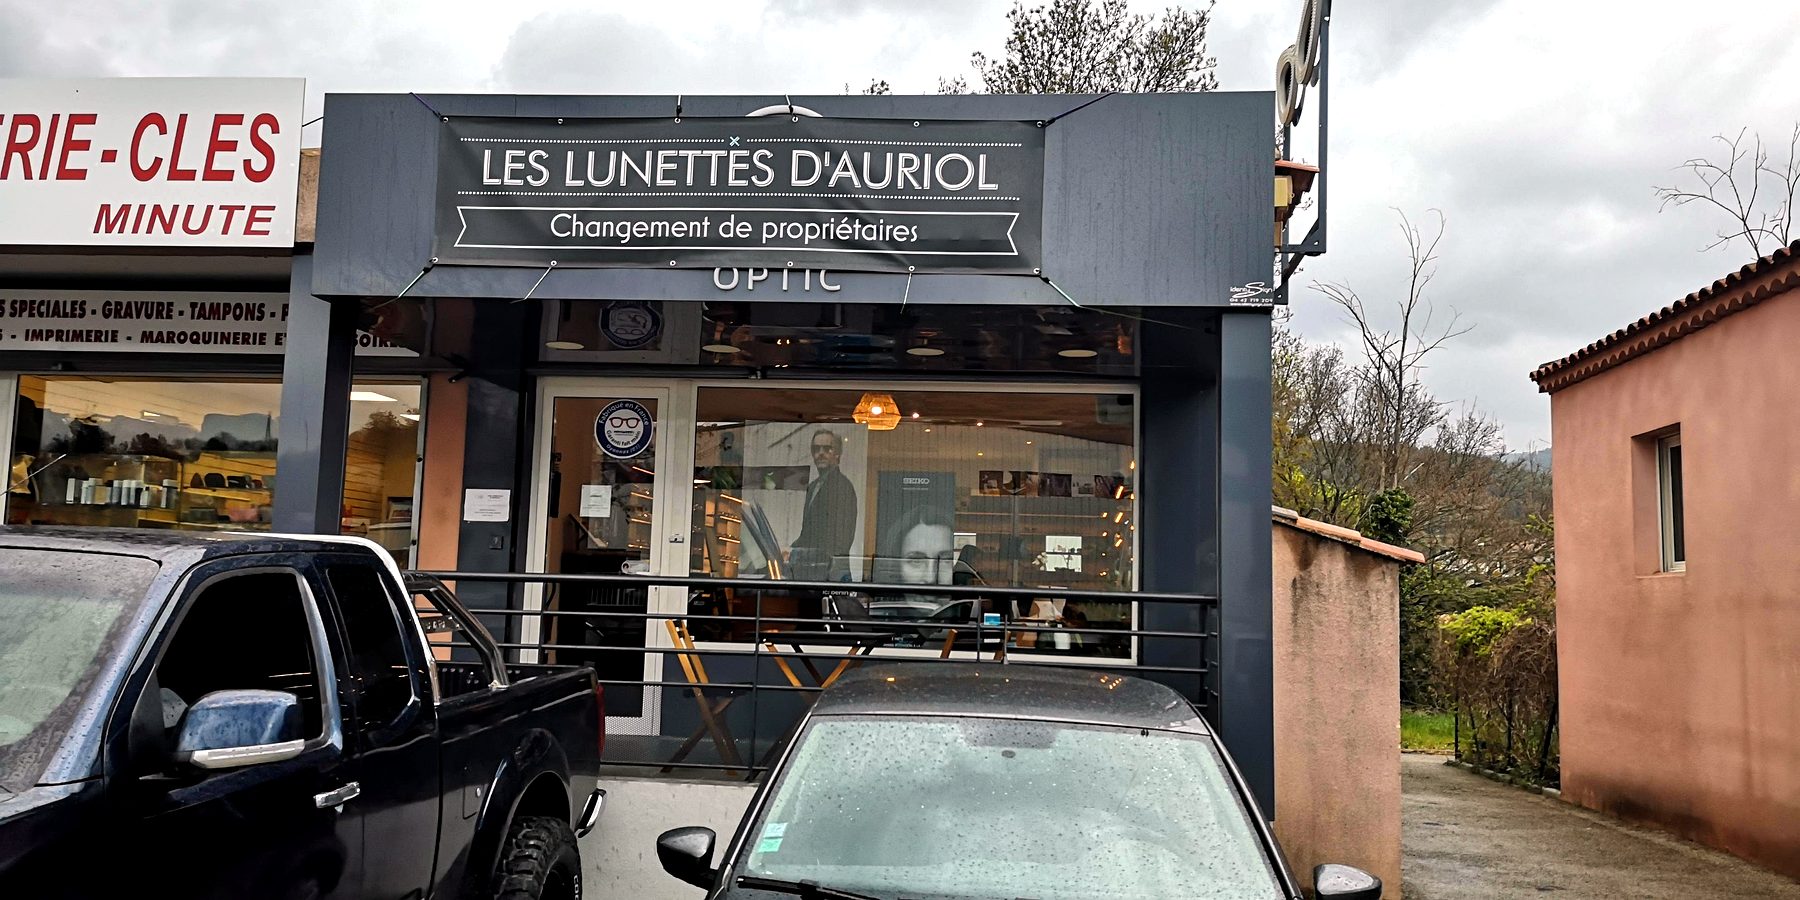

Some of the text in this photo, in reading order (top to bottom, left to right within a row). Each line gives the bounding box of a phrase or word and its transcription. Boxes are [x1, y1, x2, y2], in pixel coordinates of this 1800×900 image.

[0, 113, 97, 181] RIE
[482, 148, 999, 191] LES LUNETTES D'AURIOL
[93, 203, 275, 236] MINUTE
[550, 212, 919, 248] Changement de propriétaires
[9, 299, 87, 319] SPECIALES
[102, 300, 174, 320] GRAVURE
[189, 301, 265, 322] TAMPONS
[24, 328, 119, 343] IMPRIMERIE
[140, 330, 267, 346] MAROQUINERIE
